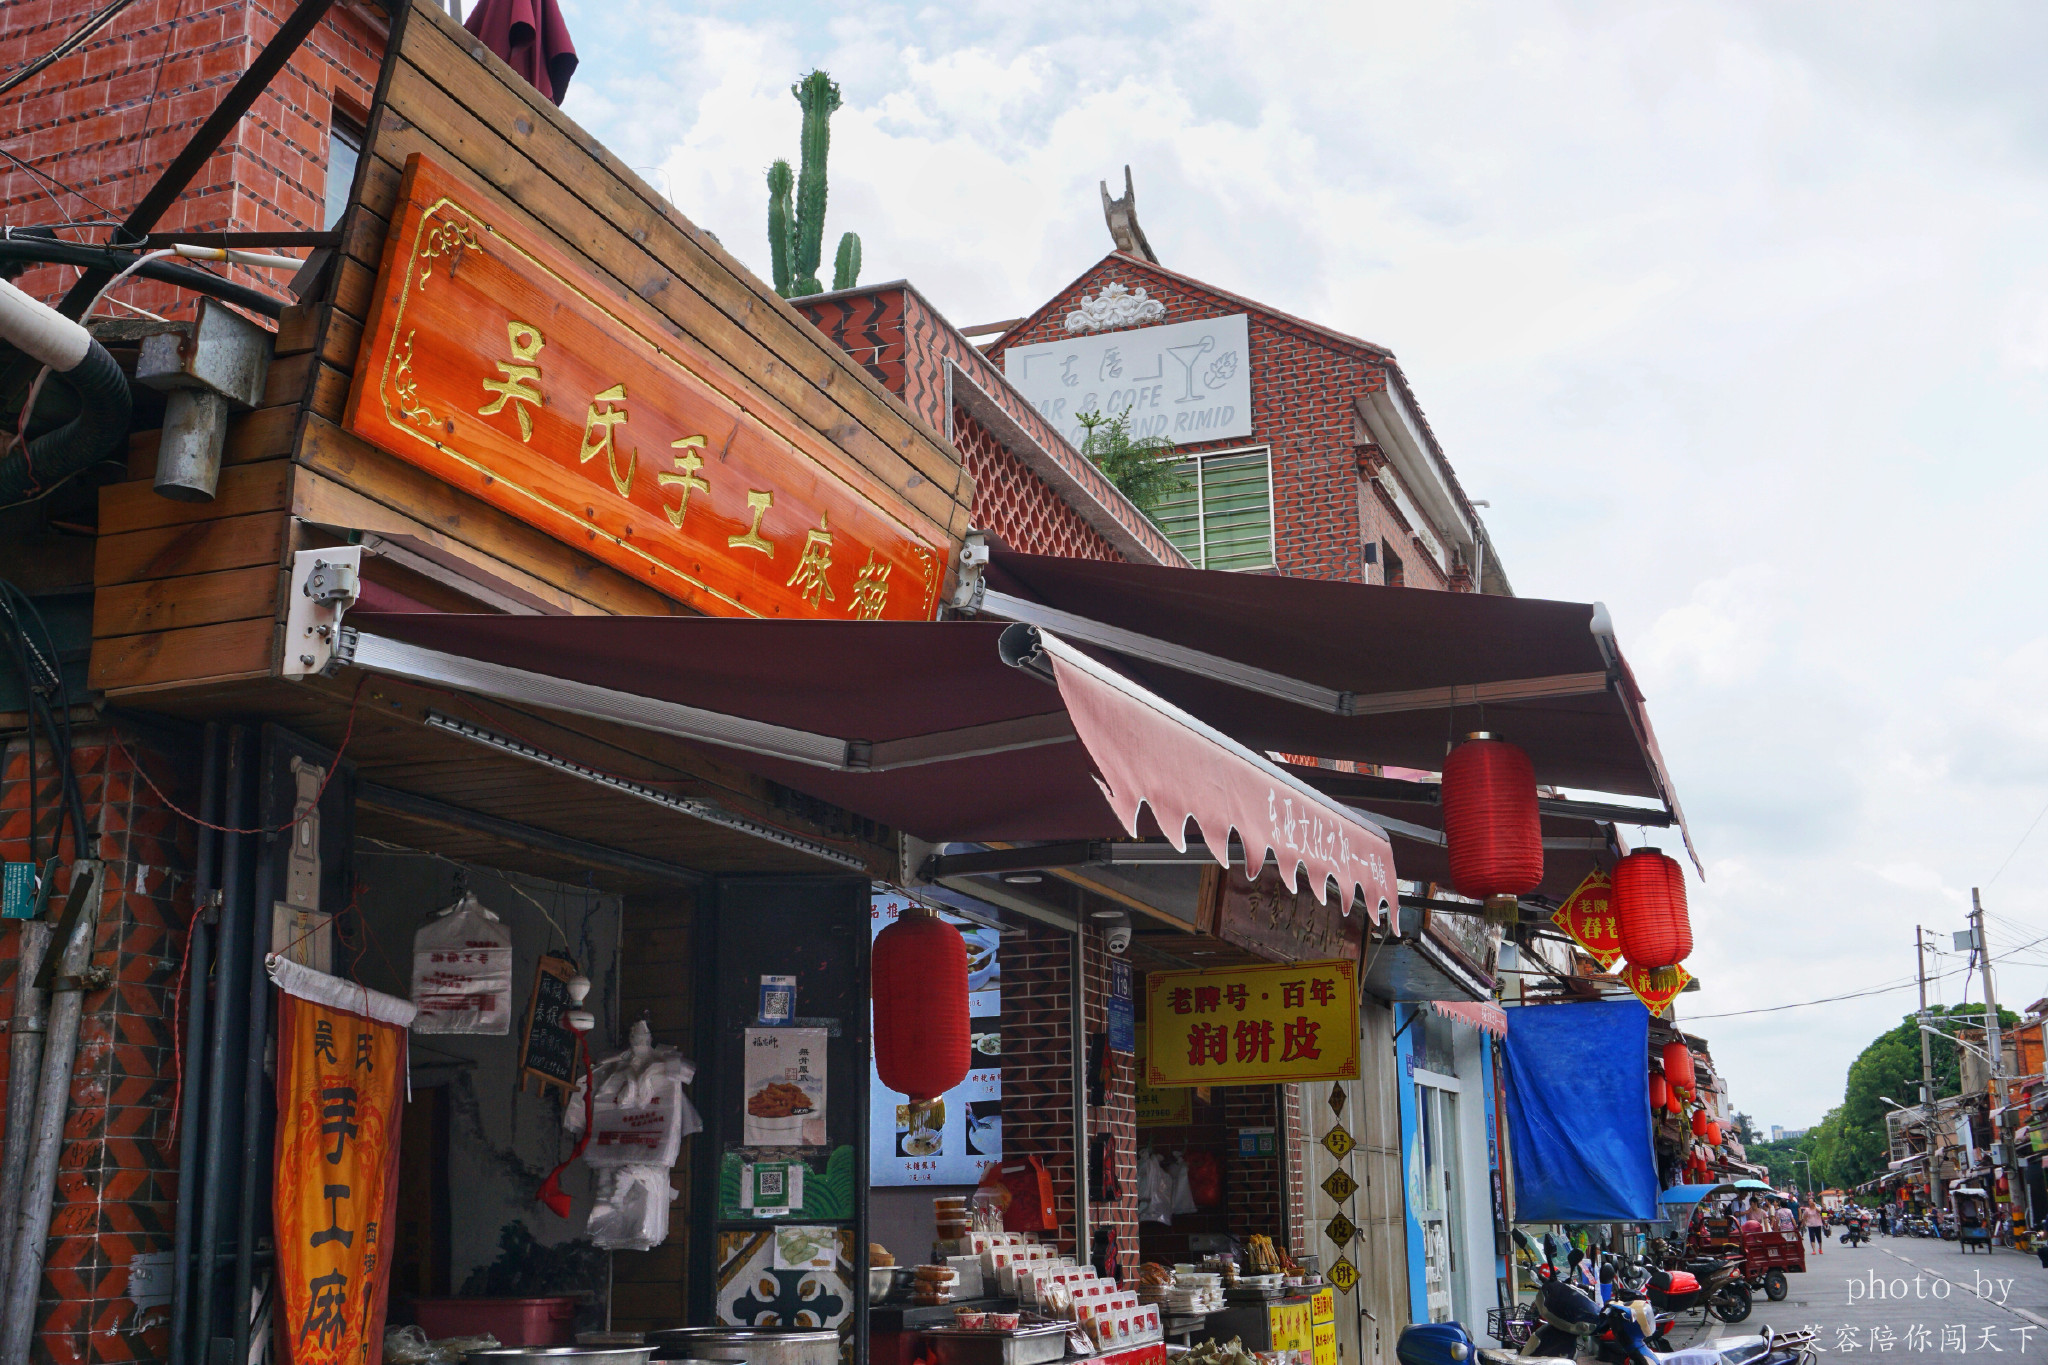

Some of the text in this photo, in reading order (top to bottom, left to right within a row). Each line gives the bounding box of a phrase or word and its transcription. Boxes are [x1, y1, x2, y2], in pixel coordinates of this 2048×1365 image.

[1107, 384, 1164, 413] COFE
[1173, 405, 1236, 433] RIMID
[1166, 978, 1336, 1015] 老牌号·百年
[314, 1019, 374, 1073] 吴氏
[1186, 1016, 1322, 1066] 润饼皮
[300, 1086, 359, 1364] 手工麻
